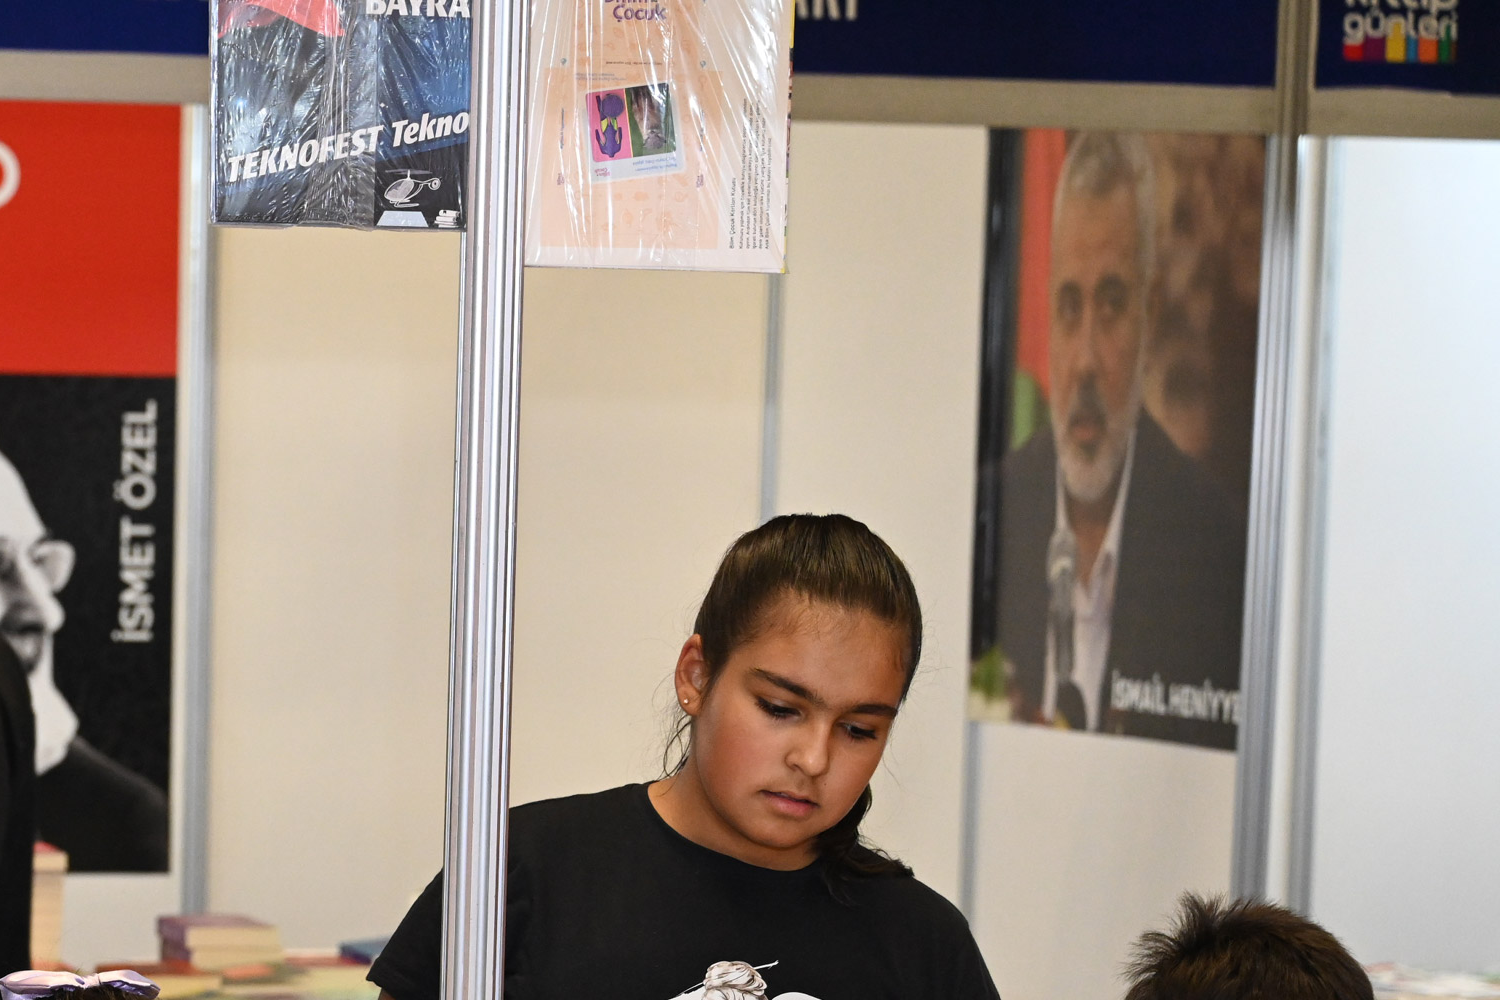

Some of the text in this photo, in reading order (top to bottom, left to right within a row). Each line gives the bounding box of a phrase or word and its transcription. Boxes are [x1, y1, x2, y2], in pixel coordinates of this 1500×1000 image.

[612, 3, 668, 22] Çocuk
[227, 112, 470, 183] TEKNOFEST Tekno
[111, 400, 157, 644] İSMET ÖZEL
